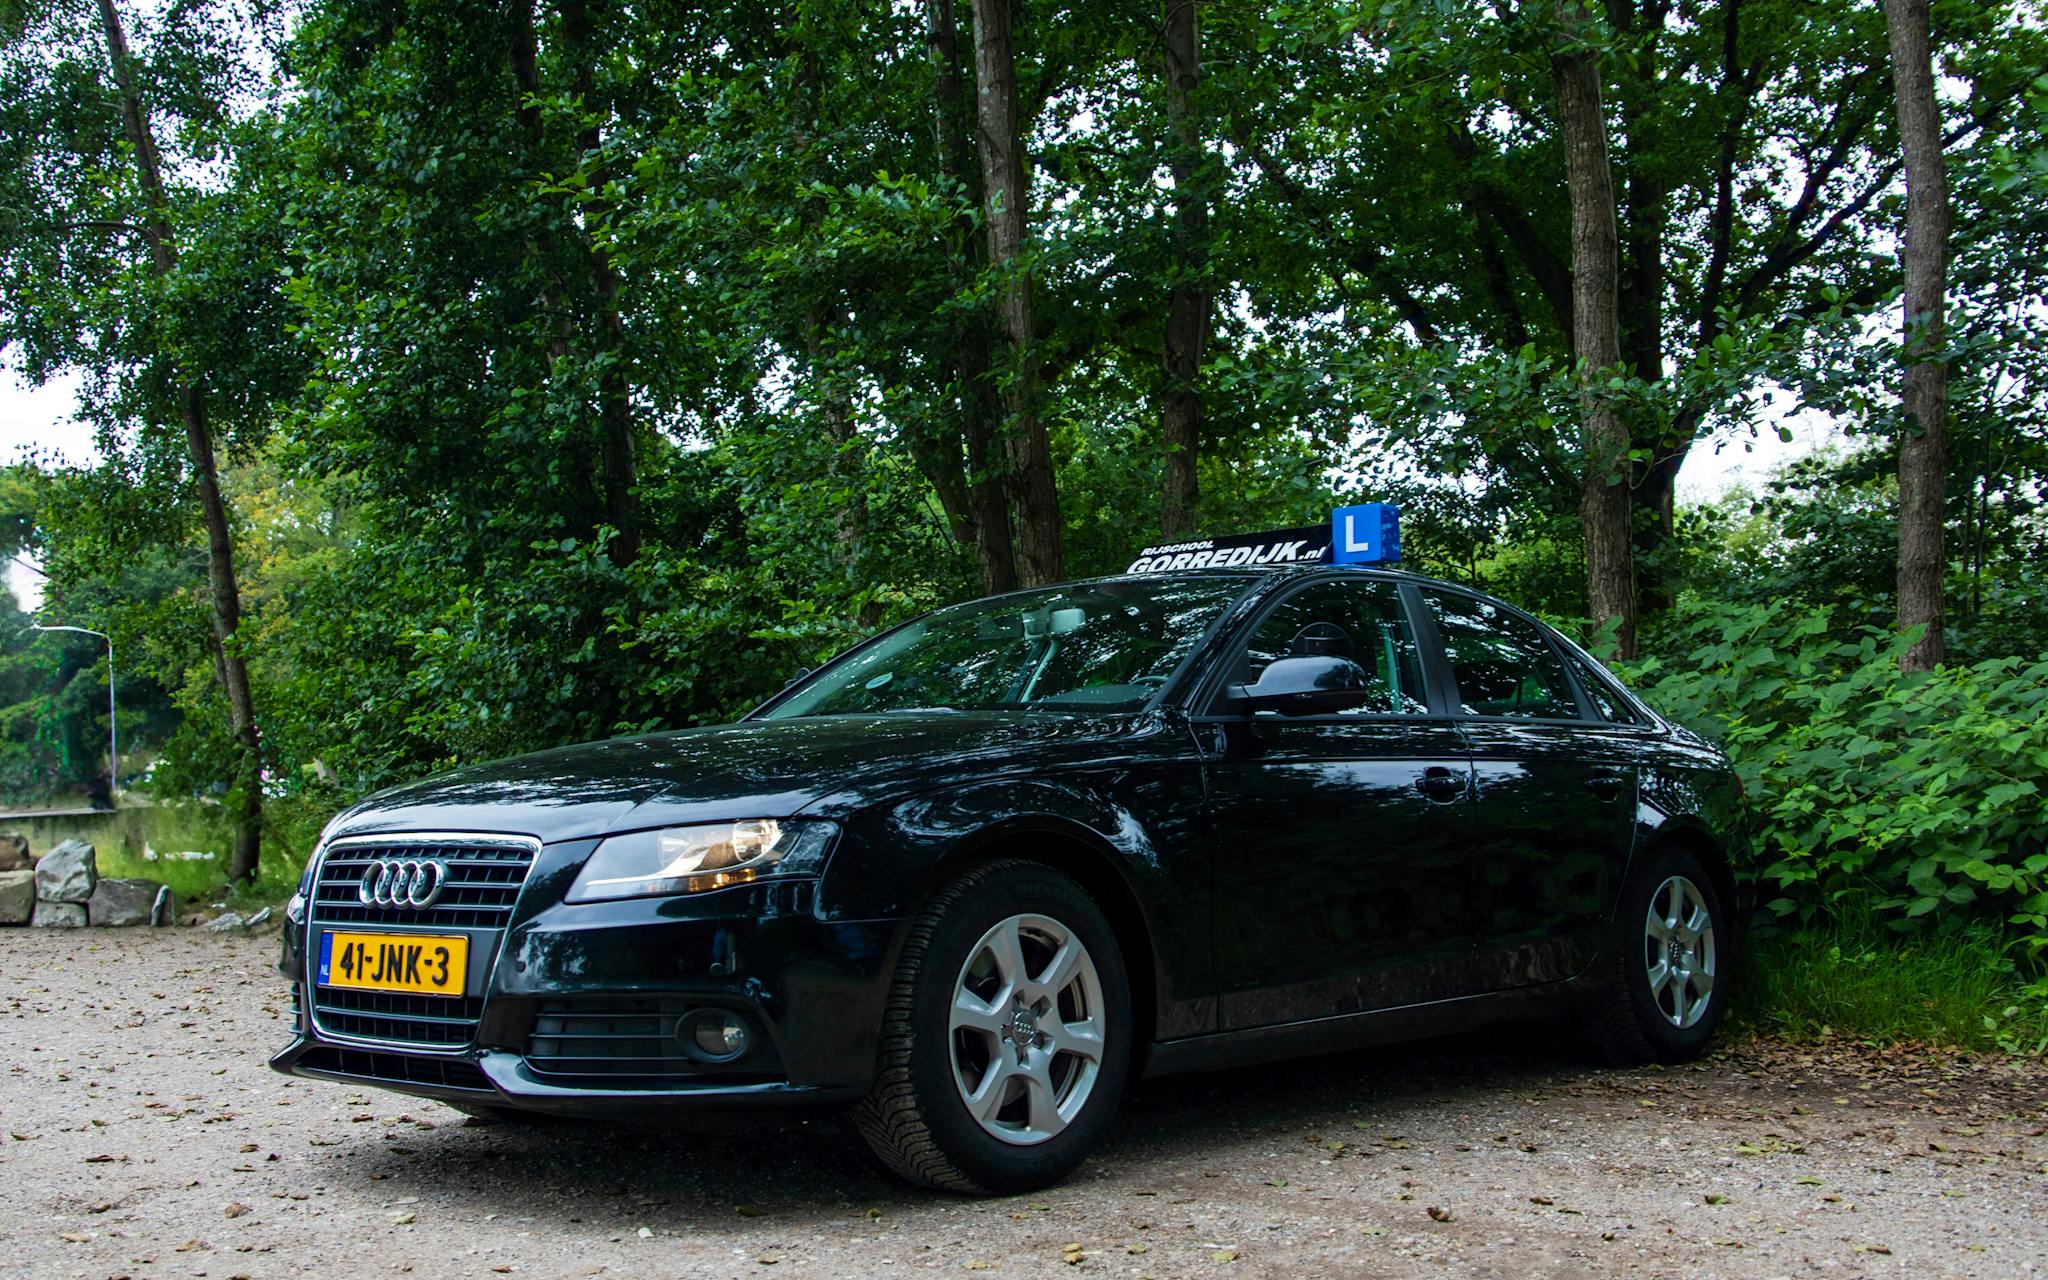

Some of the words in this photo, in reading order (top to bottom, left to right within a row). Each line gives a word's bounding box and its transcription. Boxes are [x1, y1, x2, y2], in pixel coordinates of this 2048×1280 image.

[1345, 514, 1369, 553] L
[1140, 540, 1214, 556] RIJSCHOOL
[320, 964, 329, 976] NL
[340, 942, 450, 987] 41-JNK-3
